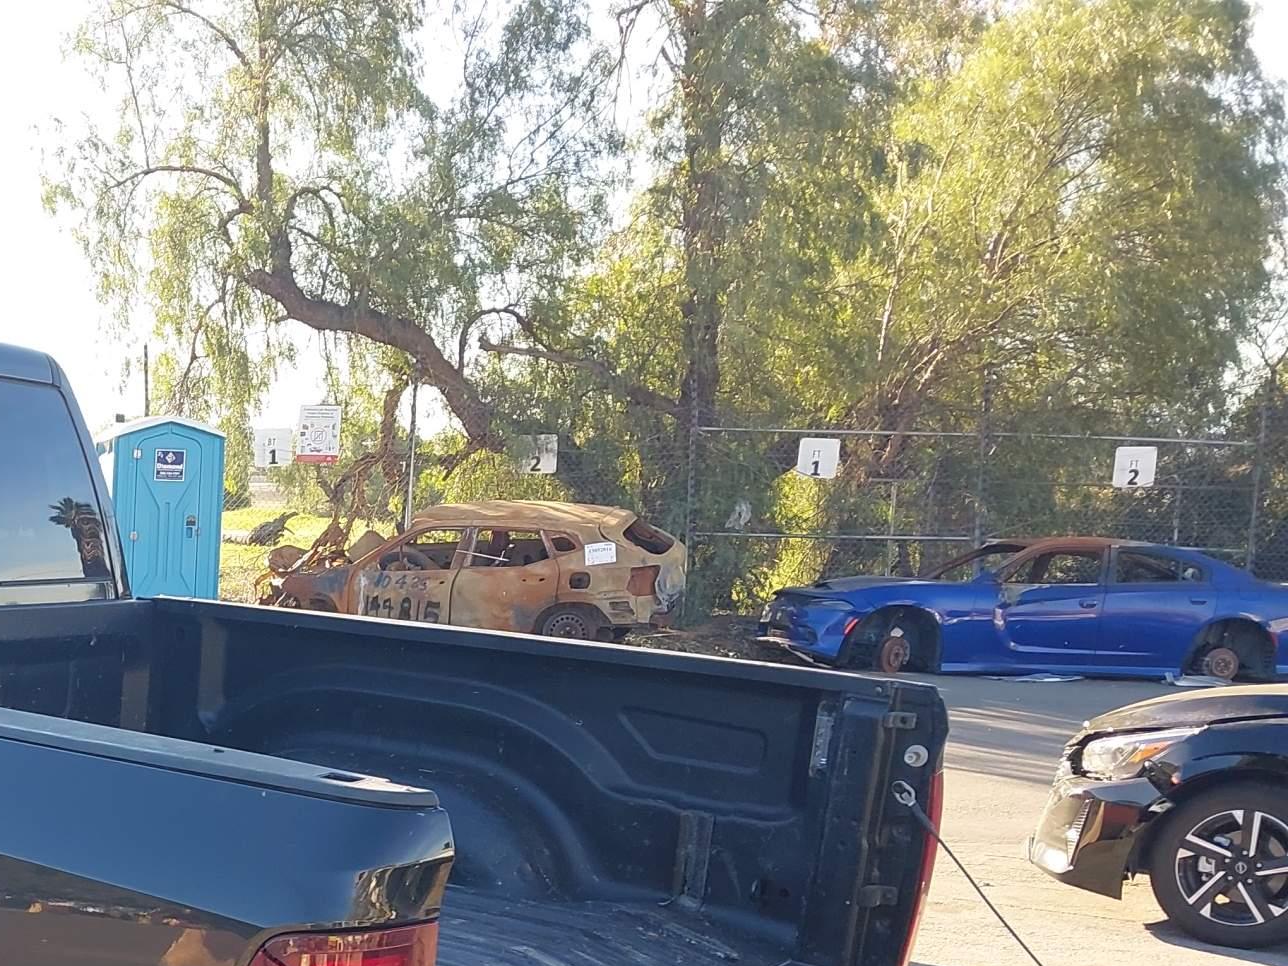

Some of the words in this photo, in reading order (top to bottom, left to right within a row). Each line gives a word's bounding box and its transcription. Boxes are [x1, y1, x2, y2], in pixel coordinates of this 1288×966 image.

[269, 449, 278, 464] 1
[530, 456, 541, 472] 2
[811, 461, 820, 476] 1
[1128, 469, 1140, 485] 2
